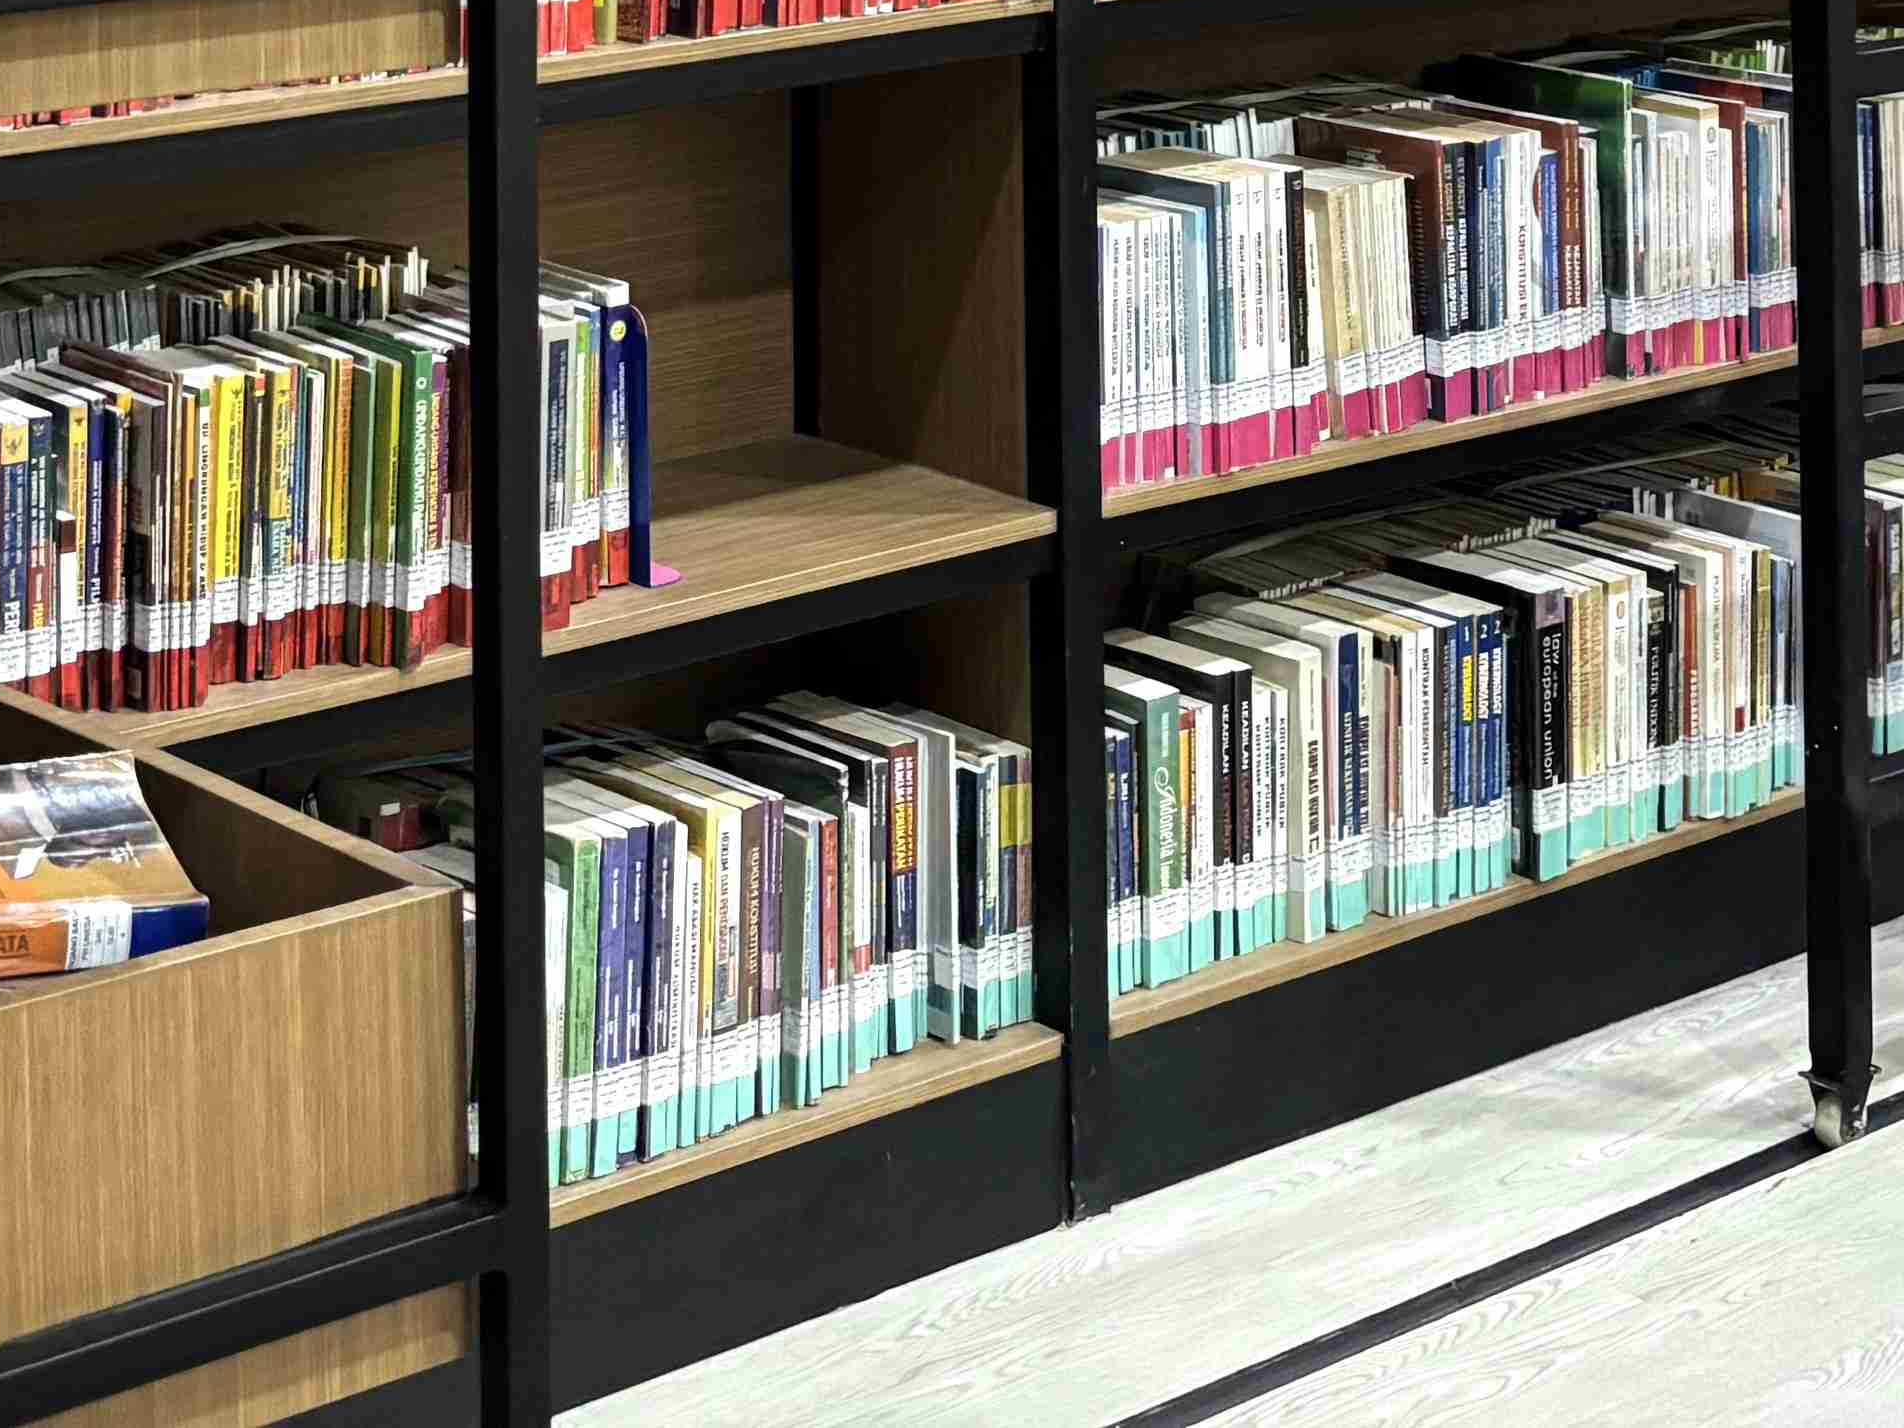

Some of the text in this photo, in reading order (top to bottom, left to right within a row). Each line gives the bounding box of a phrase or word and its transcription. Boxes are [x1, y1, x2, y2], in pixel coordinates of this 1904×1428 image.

[1552, 633, 1563, 664] law
[1221, 703, 1231, 774] KEADILAN
[1241, 700, 1250, 770] KEADILAN
[1542, 635, 1556, 779] european union
[895, 804, 906, 870] PERIKATAN
[1154, 767, 1177, 859] Indonesia
